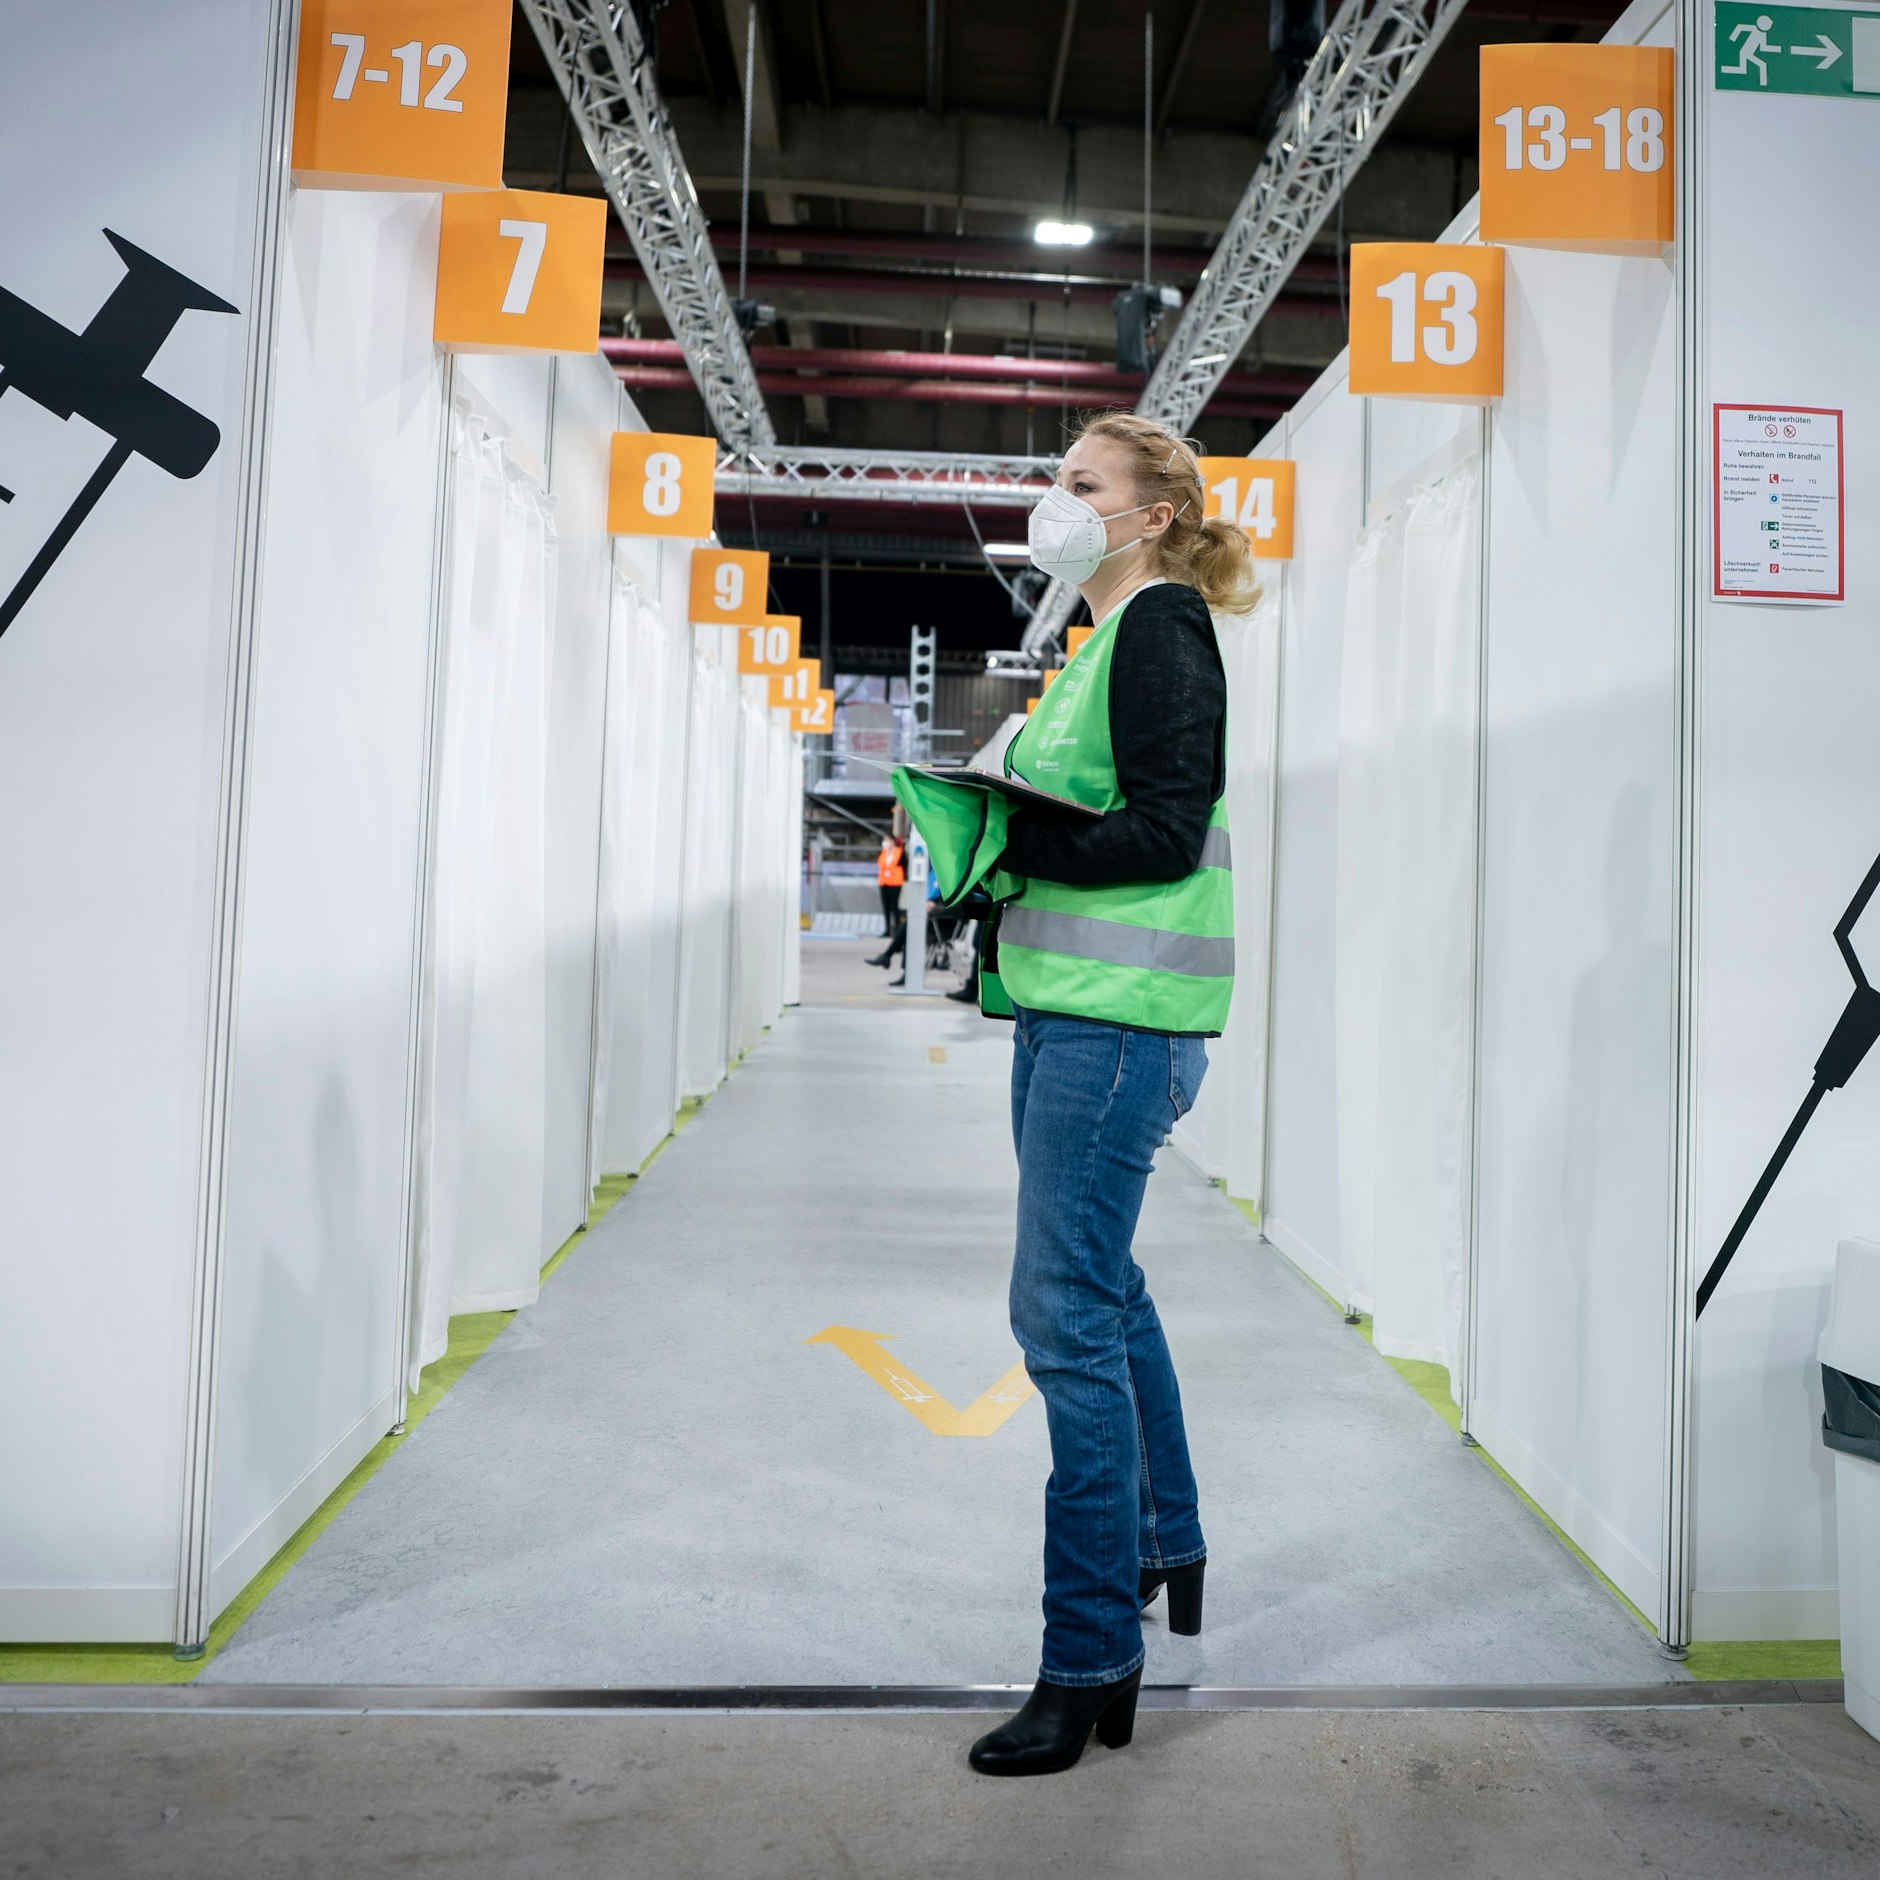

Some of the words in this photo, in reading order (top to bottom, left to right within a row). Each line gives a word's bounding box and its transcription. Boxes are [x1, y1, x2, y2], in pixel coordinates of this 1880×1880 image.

[331, 33, 468, 113] 7-12
[1494, 105, 1664, 173] 13-18
[499, 219, 548, 315] 7
[1375, 270, 1478, 367] 13
[1748, 414, 1776, 422] Brände
[1778, 415, 1811, 424] verhüten
[642, 451, 683, 517] 8
[1738, 450, 1774, 459] Verhalten
[1788, 452, 1821, 461] Brandfall
[1210, 476, 1277, 539] 14
[713, 562, 745, 611] 9
[747, 626, 791, 665] 10
[782, 668, 809, 700] 11
